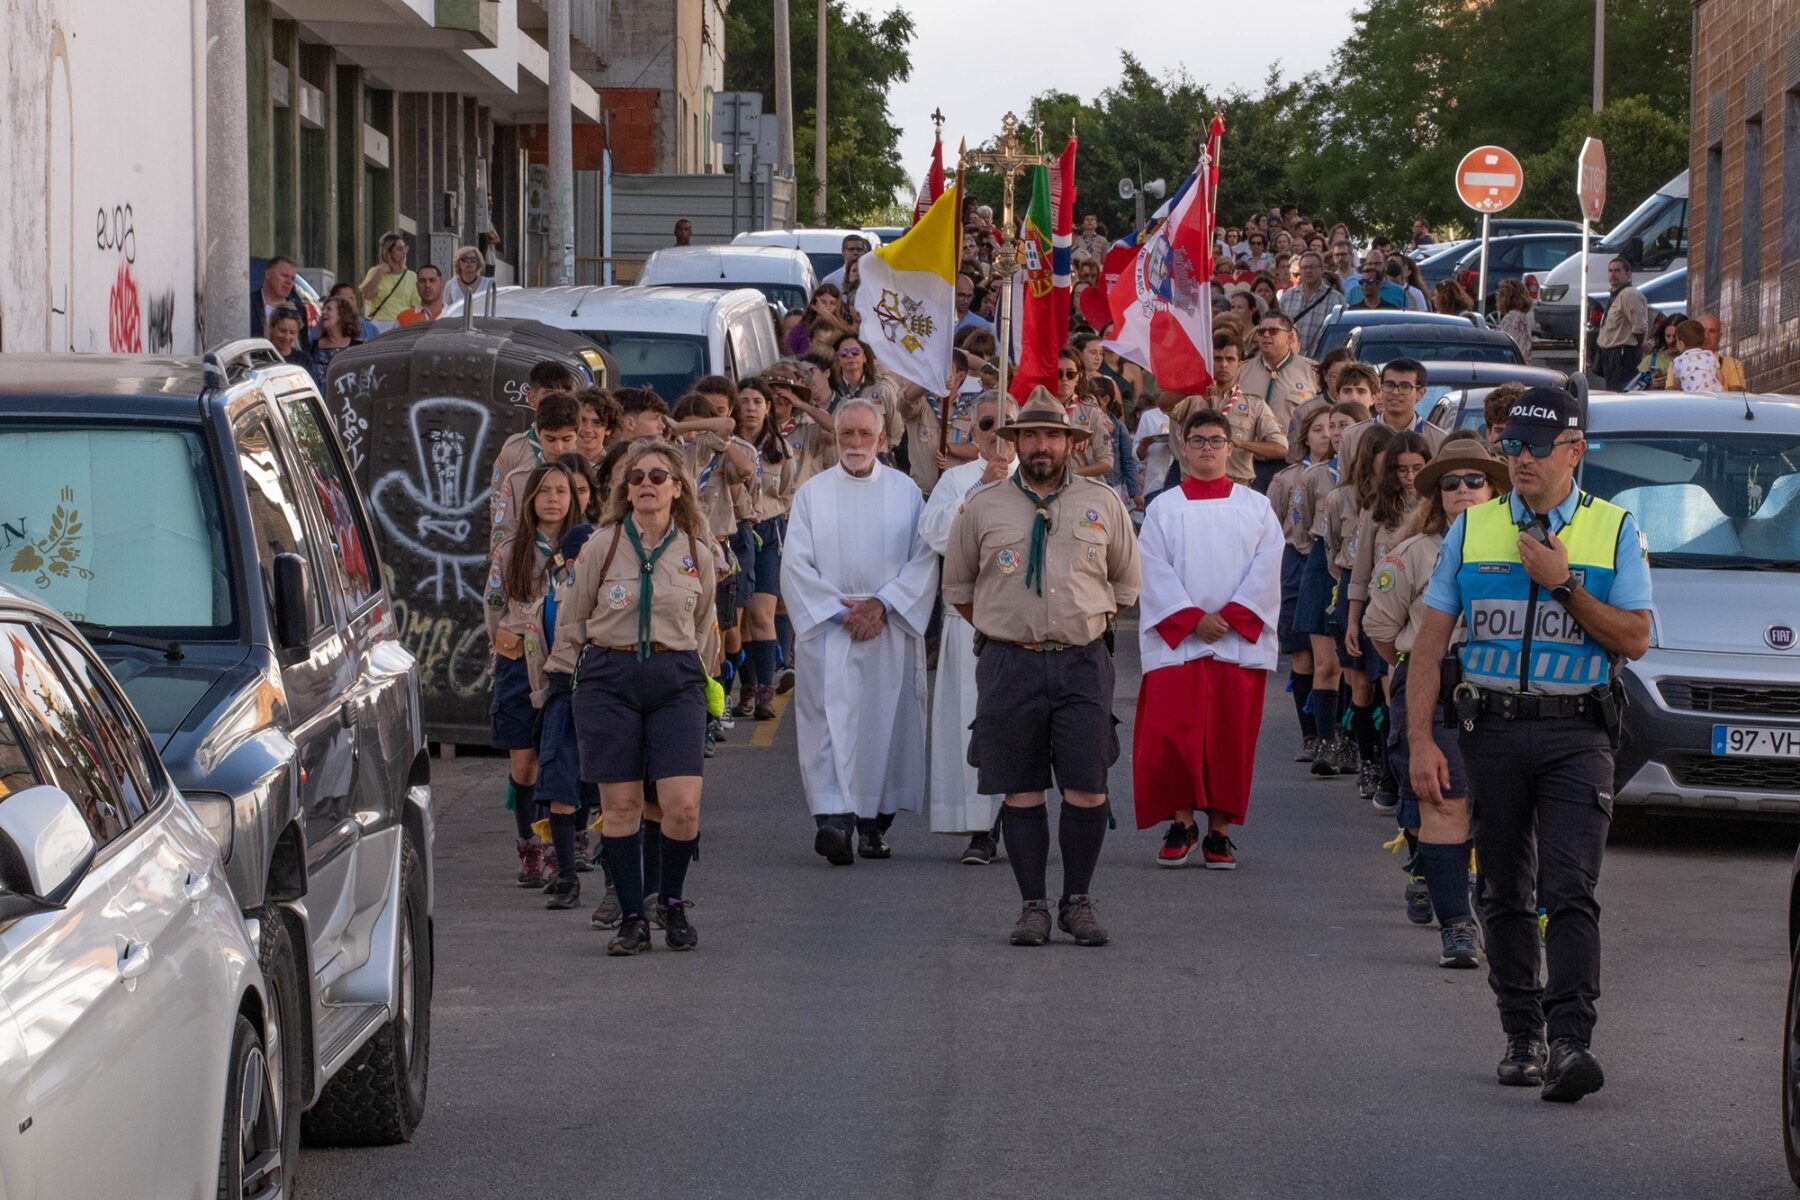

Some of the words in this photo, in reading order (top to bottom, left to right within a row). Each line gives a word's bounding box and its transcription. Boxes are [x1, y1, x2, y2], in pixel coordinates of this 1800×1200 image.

[1583, 166, 1606, 193] STOP
[1509, 405, 1558, 420] POLÍCIA
[1473, 605, 1583, 640] POLÍCIA
[1772, 630, 1791, 642] FIAT
